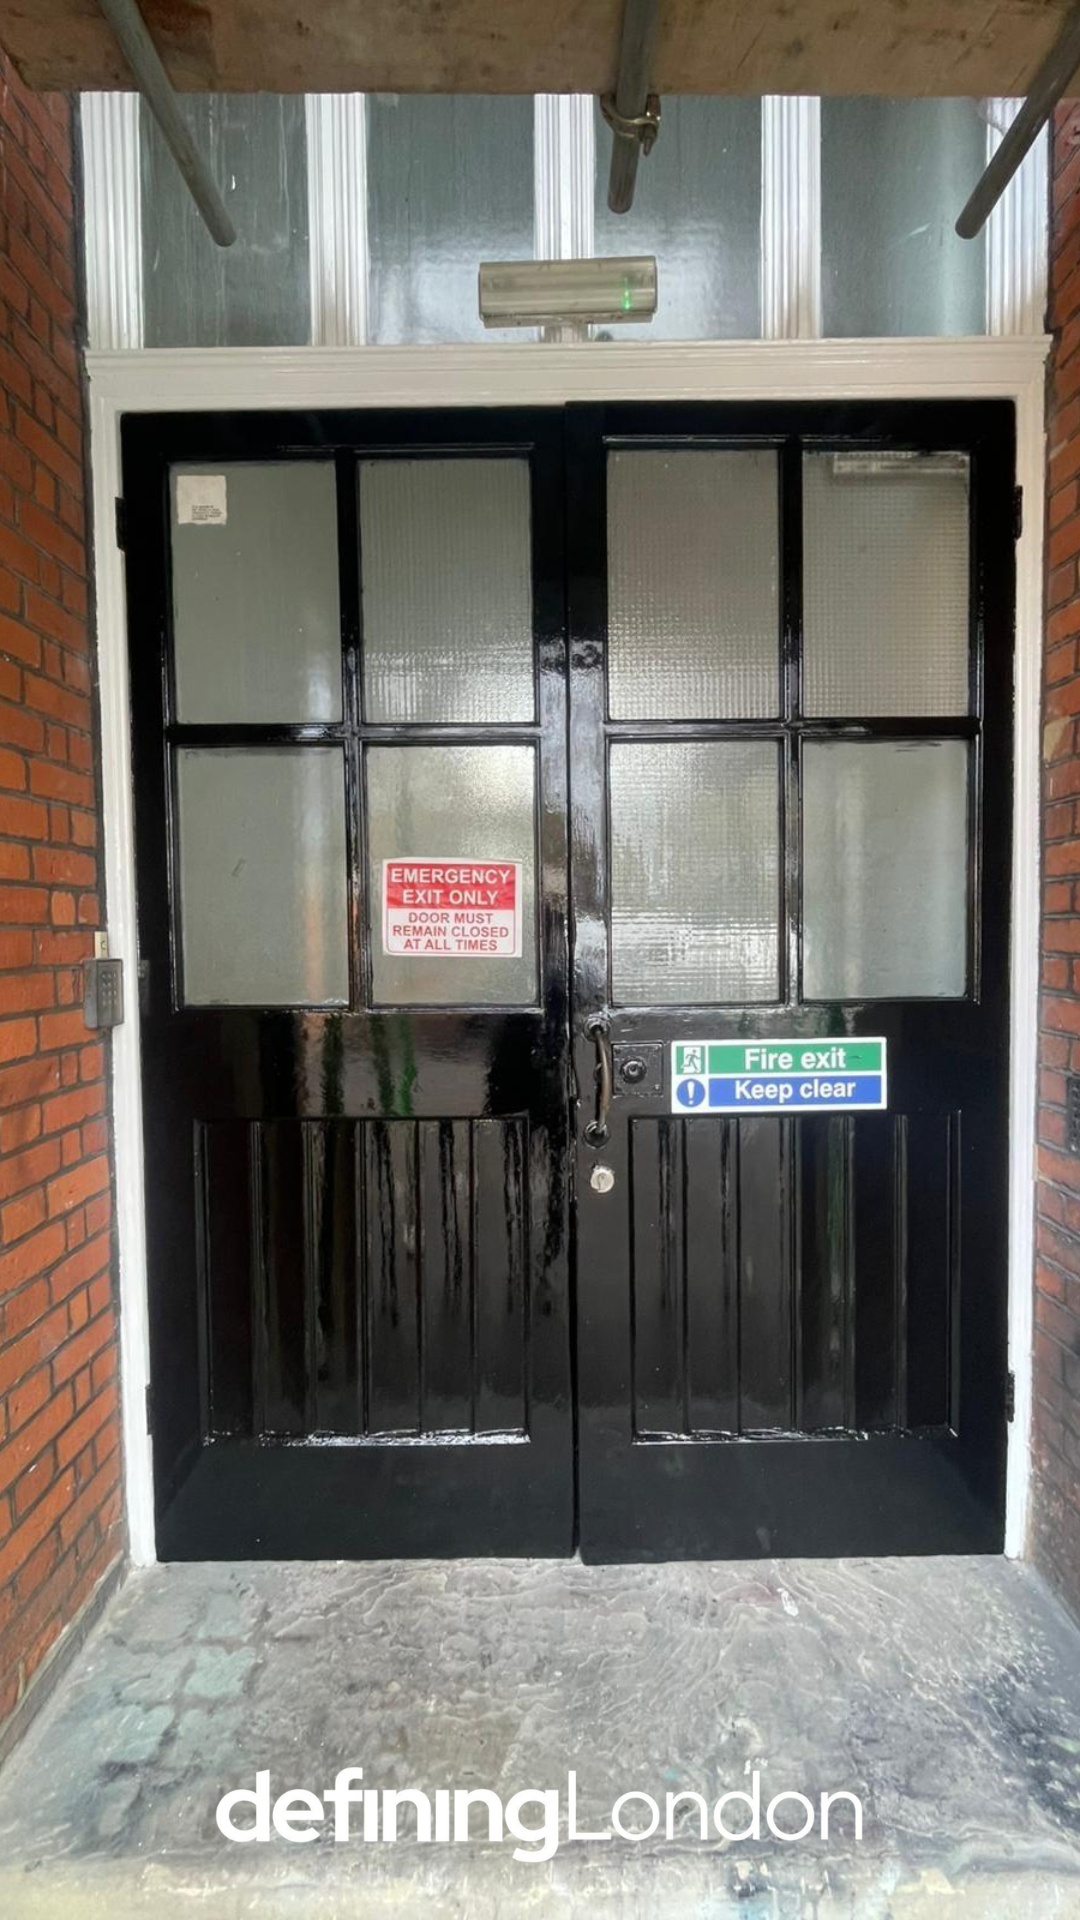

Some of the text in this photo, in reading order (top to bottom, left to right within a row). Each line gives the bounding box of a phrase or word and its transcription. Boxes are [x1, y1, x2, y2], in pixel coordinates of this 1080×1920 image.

[391, 868, 511, 884] EMERGENCY
[402, 888, 499, 906] EXIT ONLY
[408, 912, 494, 924] DOOR MUST
[392, 925, 509, 938] REMAIN CLOSED
[403, 939, 498, 951] AT ALL TIMES
[744, 1046, 846, 1070] Fire exit
[735, 1078, 856, 1103] Keep clear
